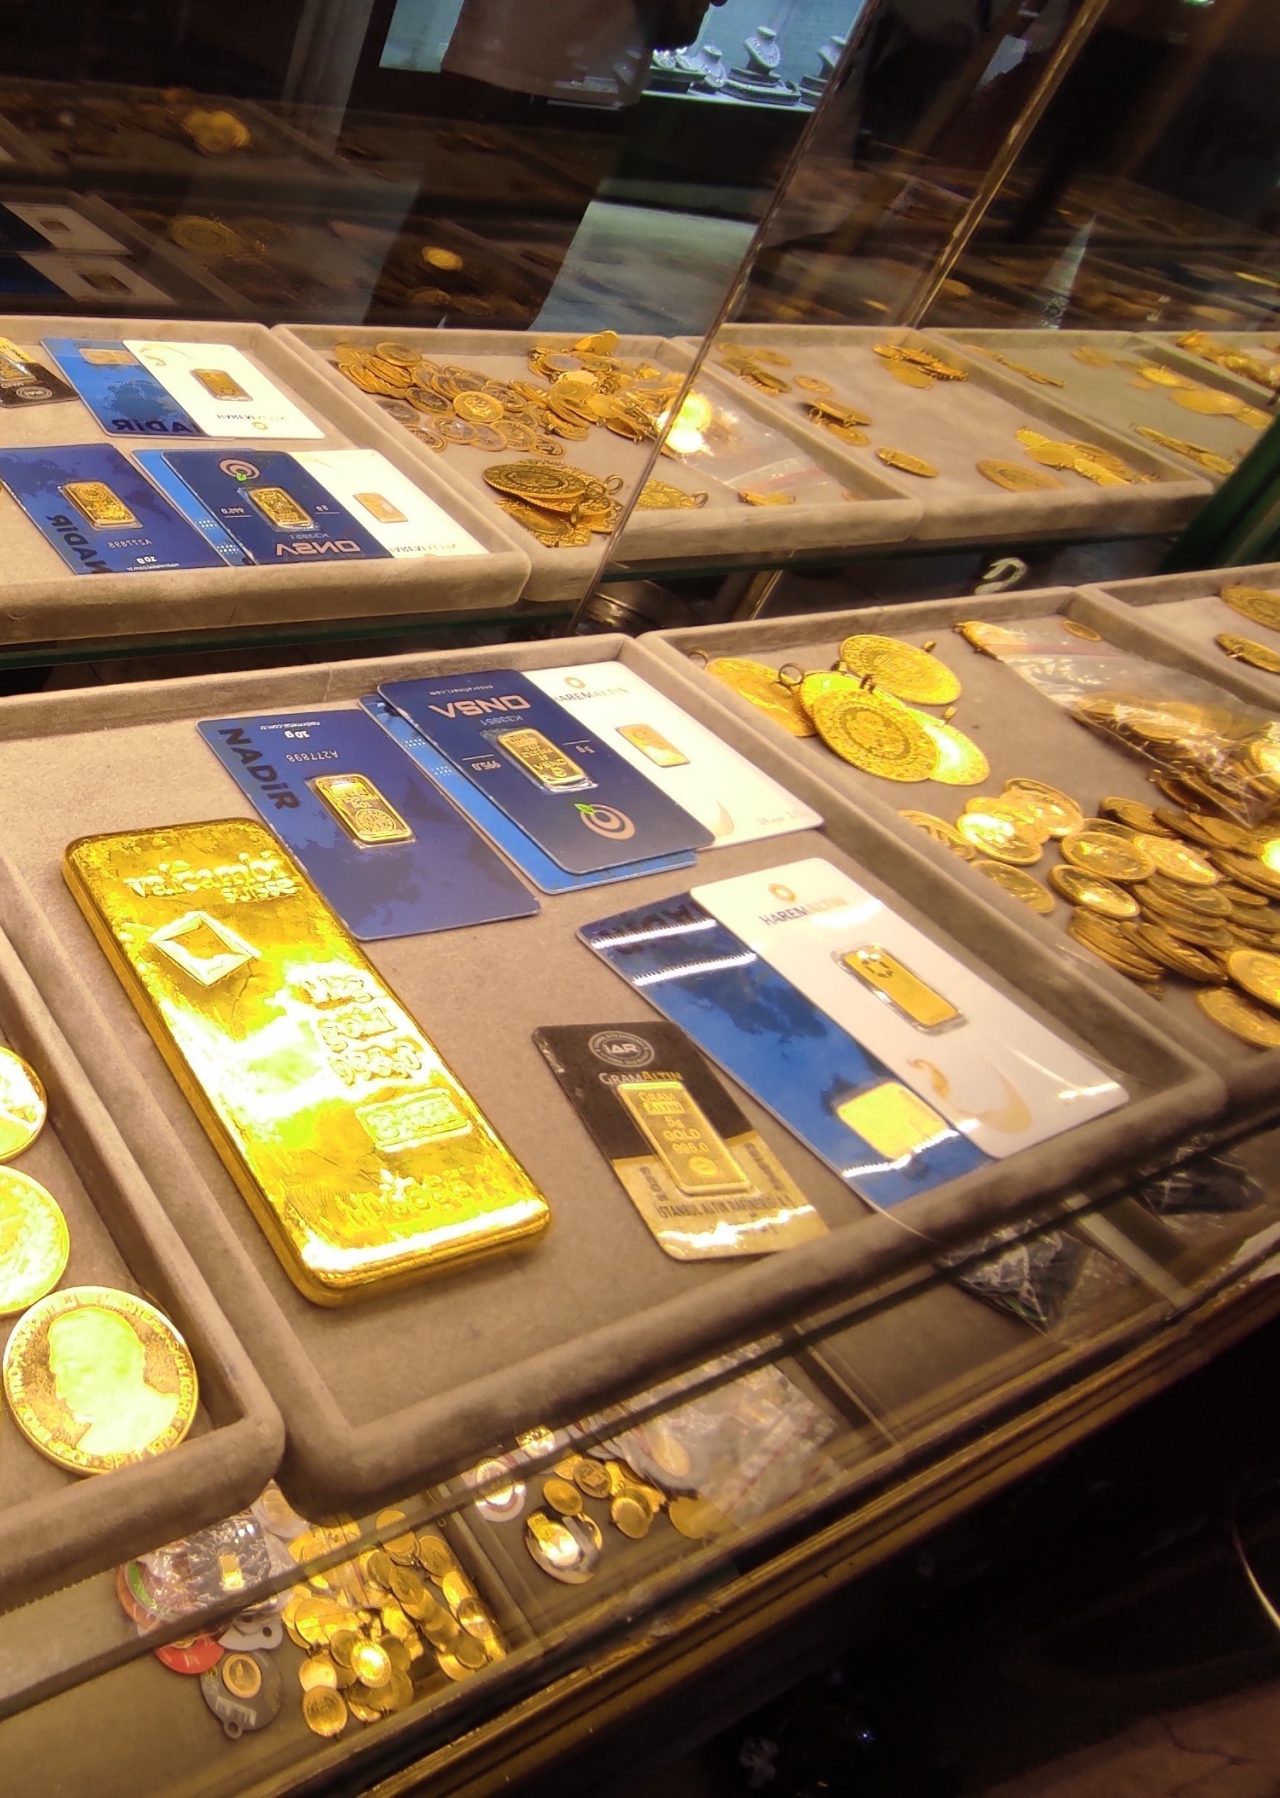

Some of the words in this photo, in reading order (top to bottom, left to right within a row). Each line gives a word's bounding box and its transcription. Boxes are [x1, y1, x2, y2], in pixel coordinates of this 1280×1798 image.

[427, 695, 531, 719] ONSA
[285, 750, 339, 763] A277898
[602, 1042, 639, 1055] IAR
